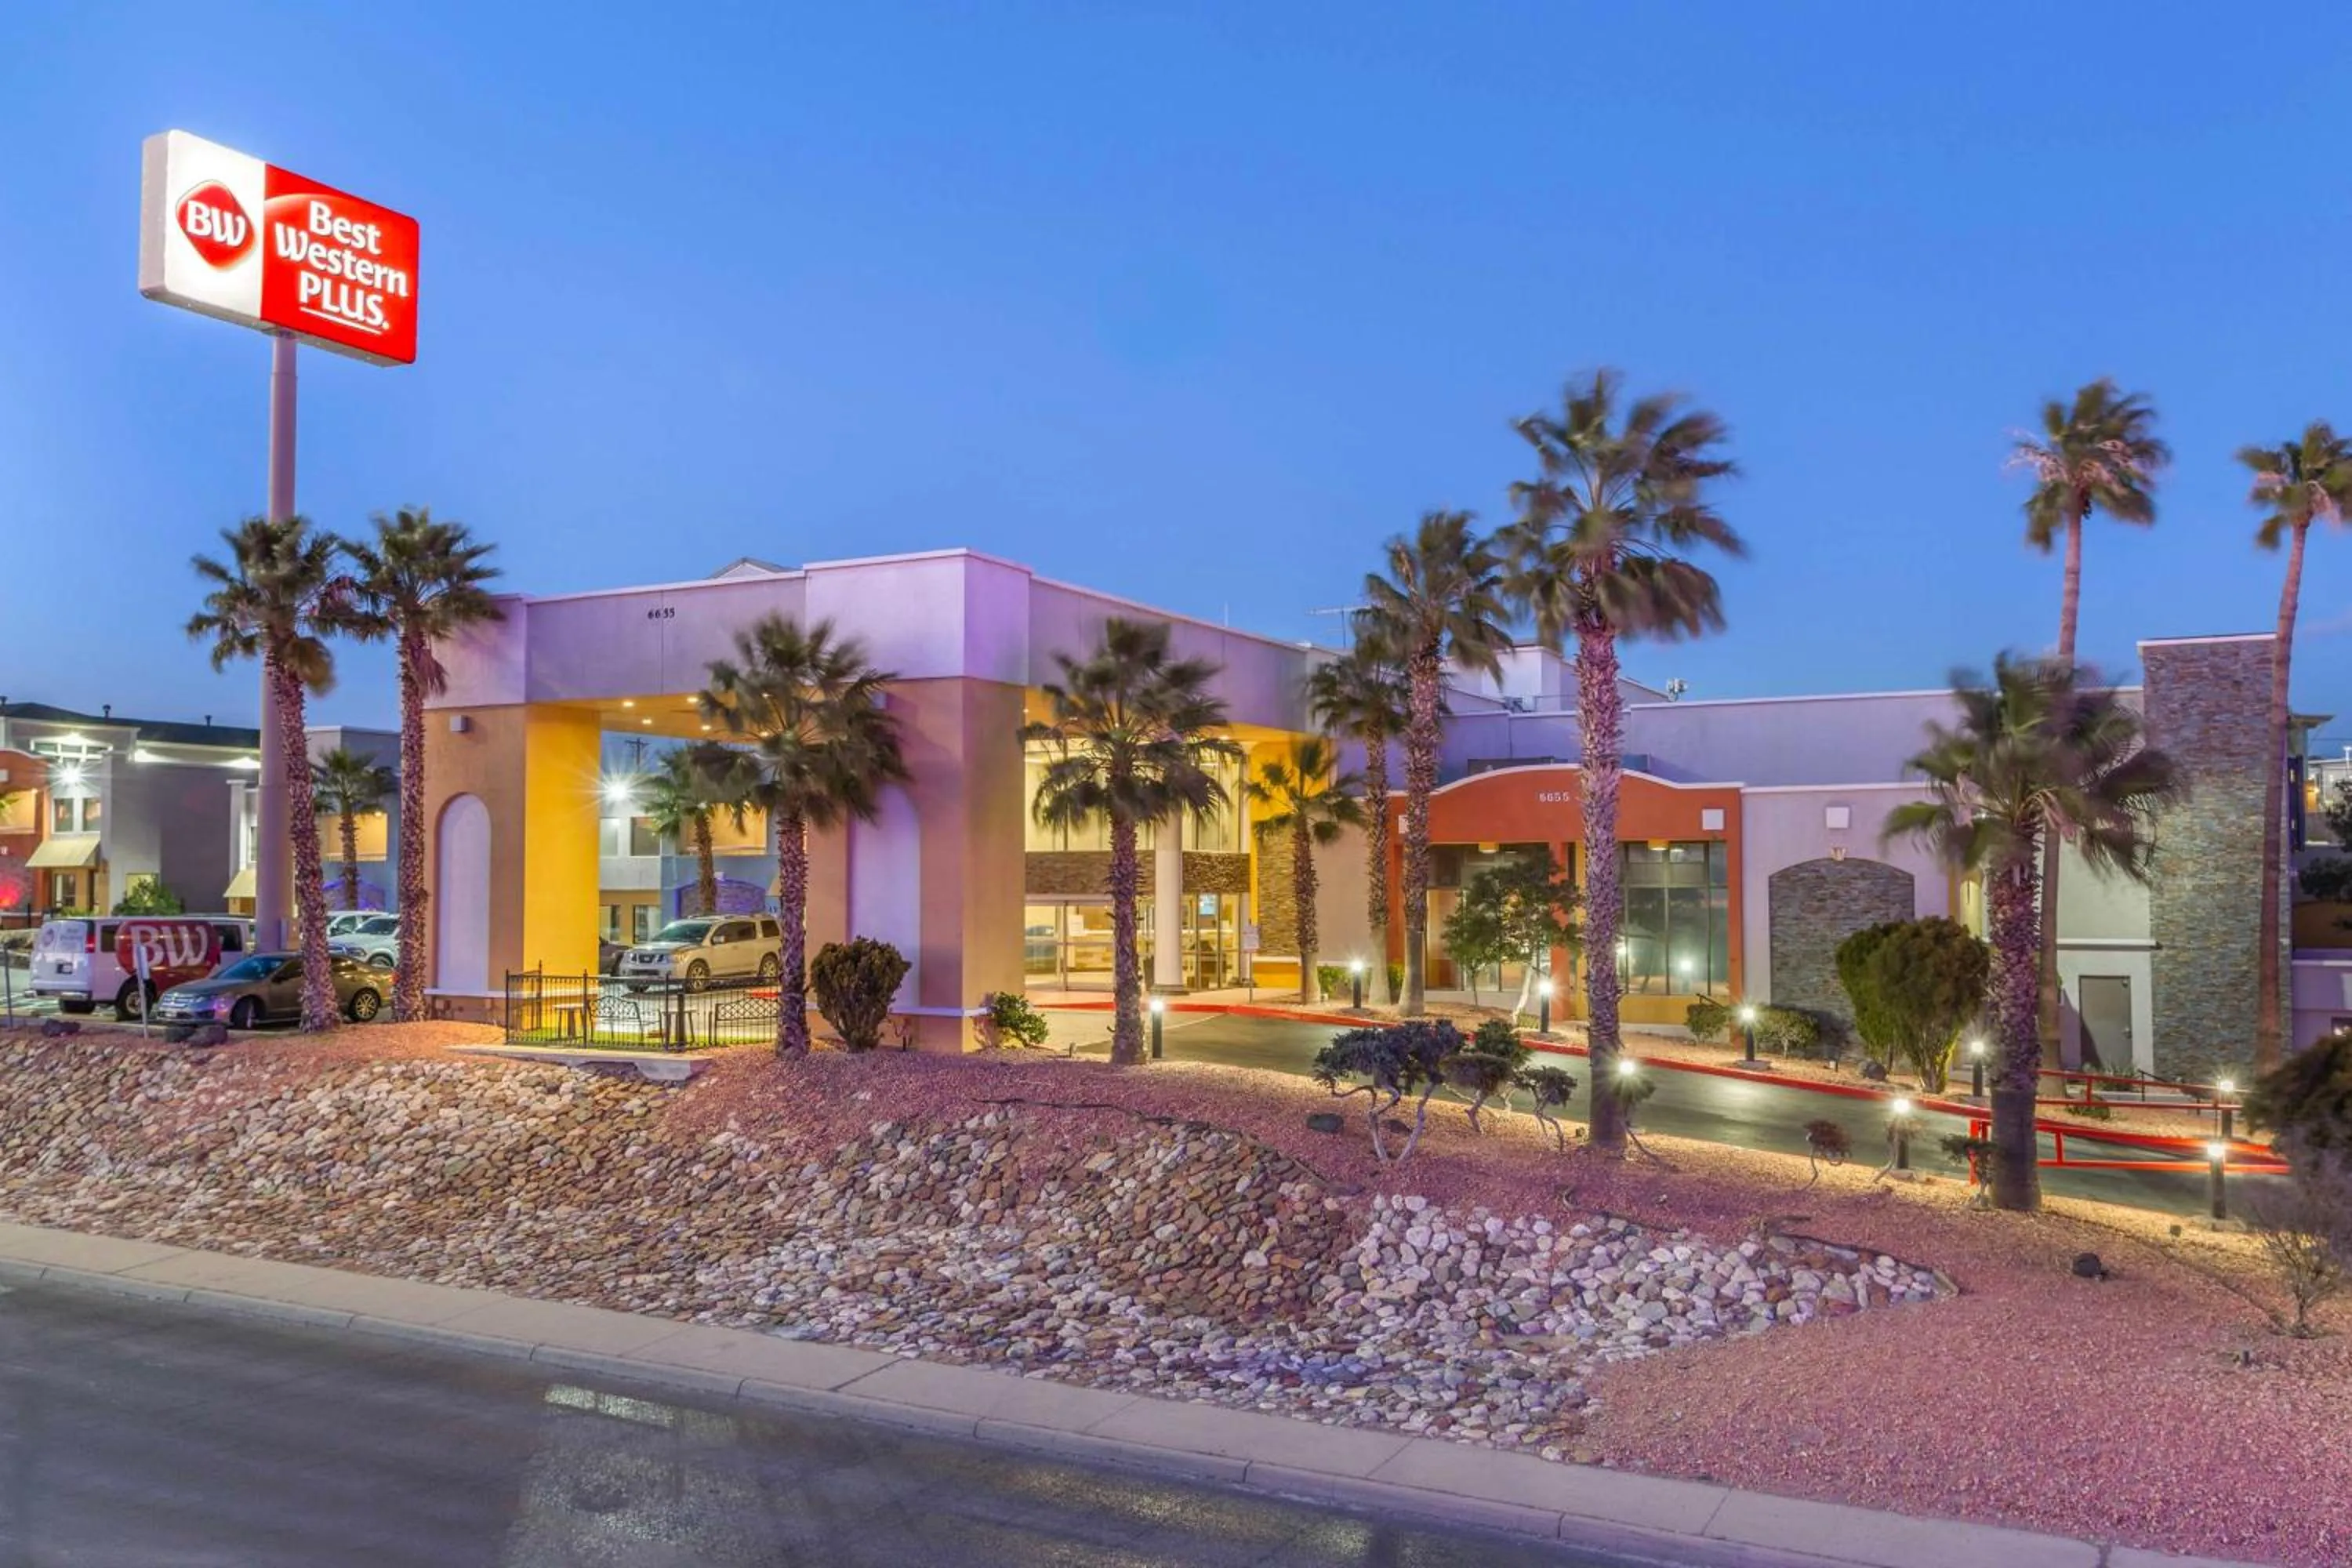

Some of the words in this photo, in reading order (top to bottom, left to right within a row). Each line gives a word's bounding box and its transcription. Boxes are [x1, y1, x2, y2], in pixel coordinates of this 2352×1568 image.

[187, 200, 246, 248] BW
[310, 200, 382, 255] Best
[274, 222, 408, 297] Western
[131, 924, 208, 967] BW
